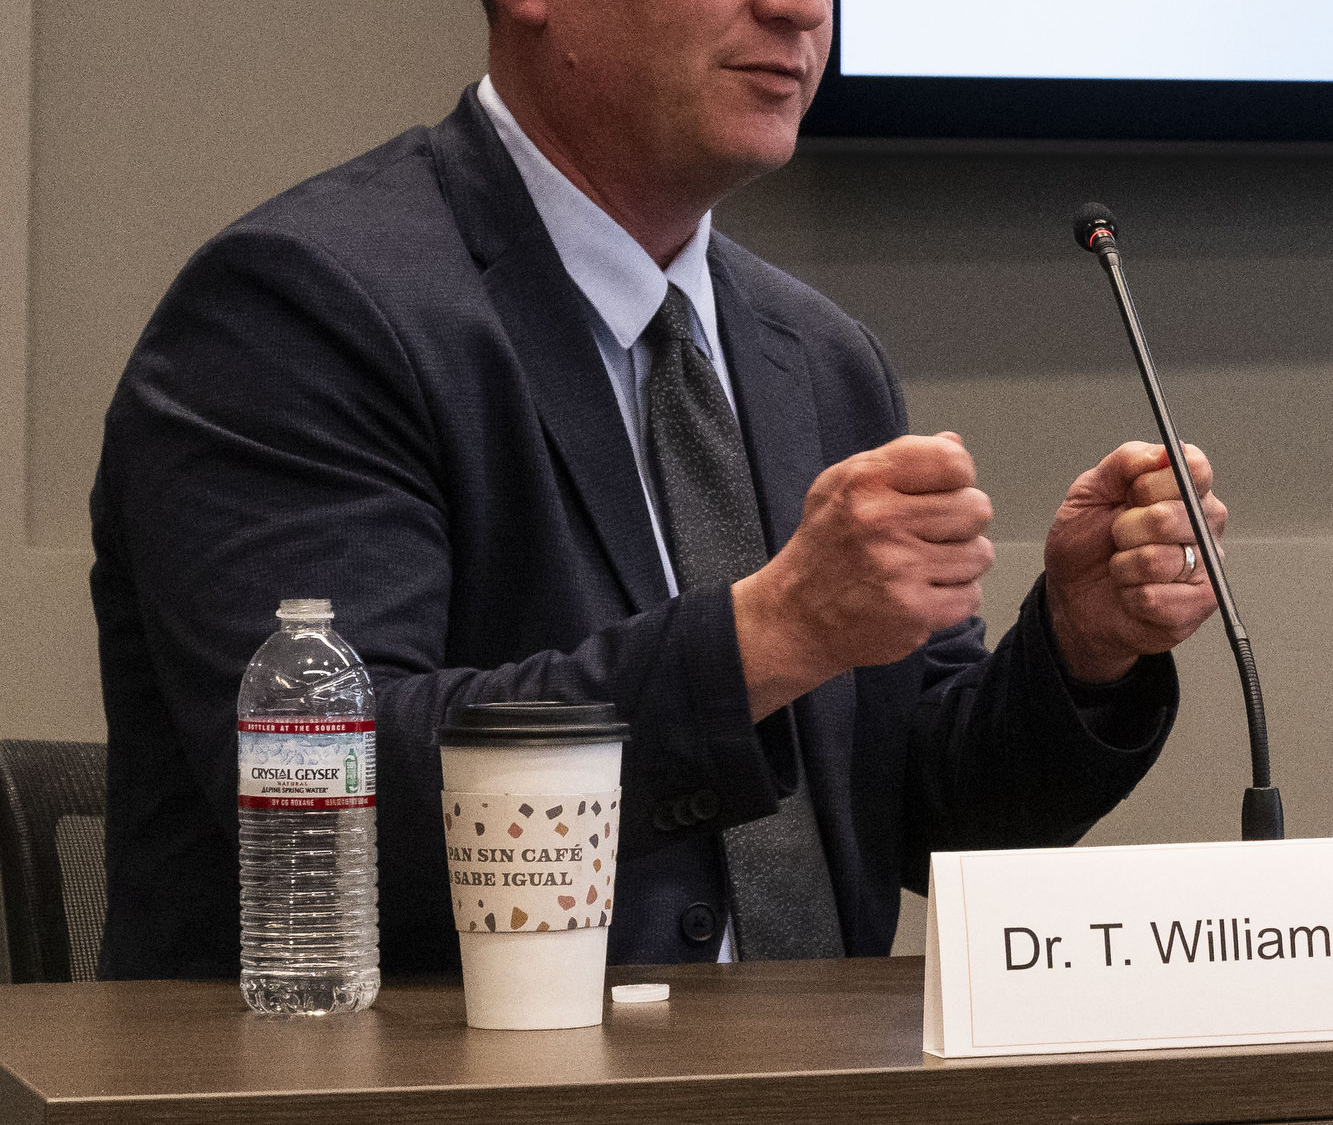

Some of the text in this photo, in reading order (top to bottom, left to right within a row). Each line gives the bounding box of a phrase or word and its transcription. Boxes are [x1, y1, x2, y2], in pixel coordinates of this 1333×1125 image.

[247, 723, 276, 731] BOTTLED
[294, 724, 310, 732] THE
[251, 767, 294, 781] CRYSTAL
[295, 767, 338, 781] GEYSER
[261, 786, 282, 794] ALPINE
[290, 798, 314, 807] ROXANE
[448, 844, 583, 863] PAN SIN CAFÉ
[454, 871, 496, 886] SABE
[501, 872, 573, 887] IGUAL
[1003, 926, 1073, 971] Dr.
[1089, 922, 1133, 967] T.
[1149, 916, 1331, 965] William
